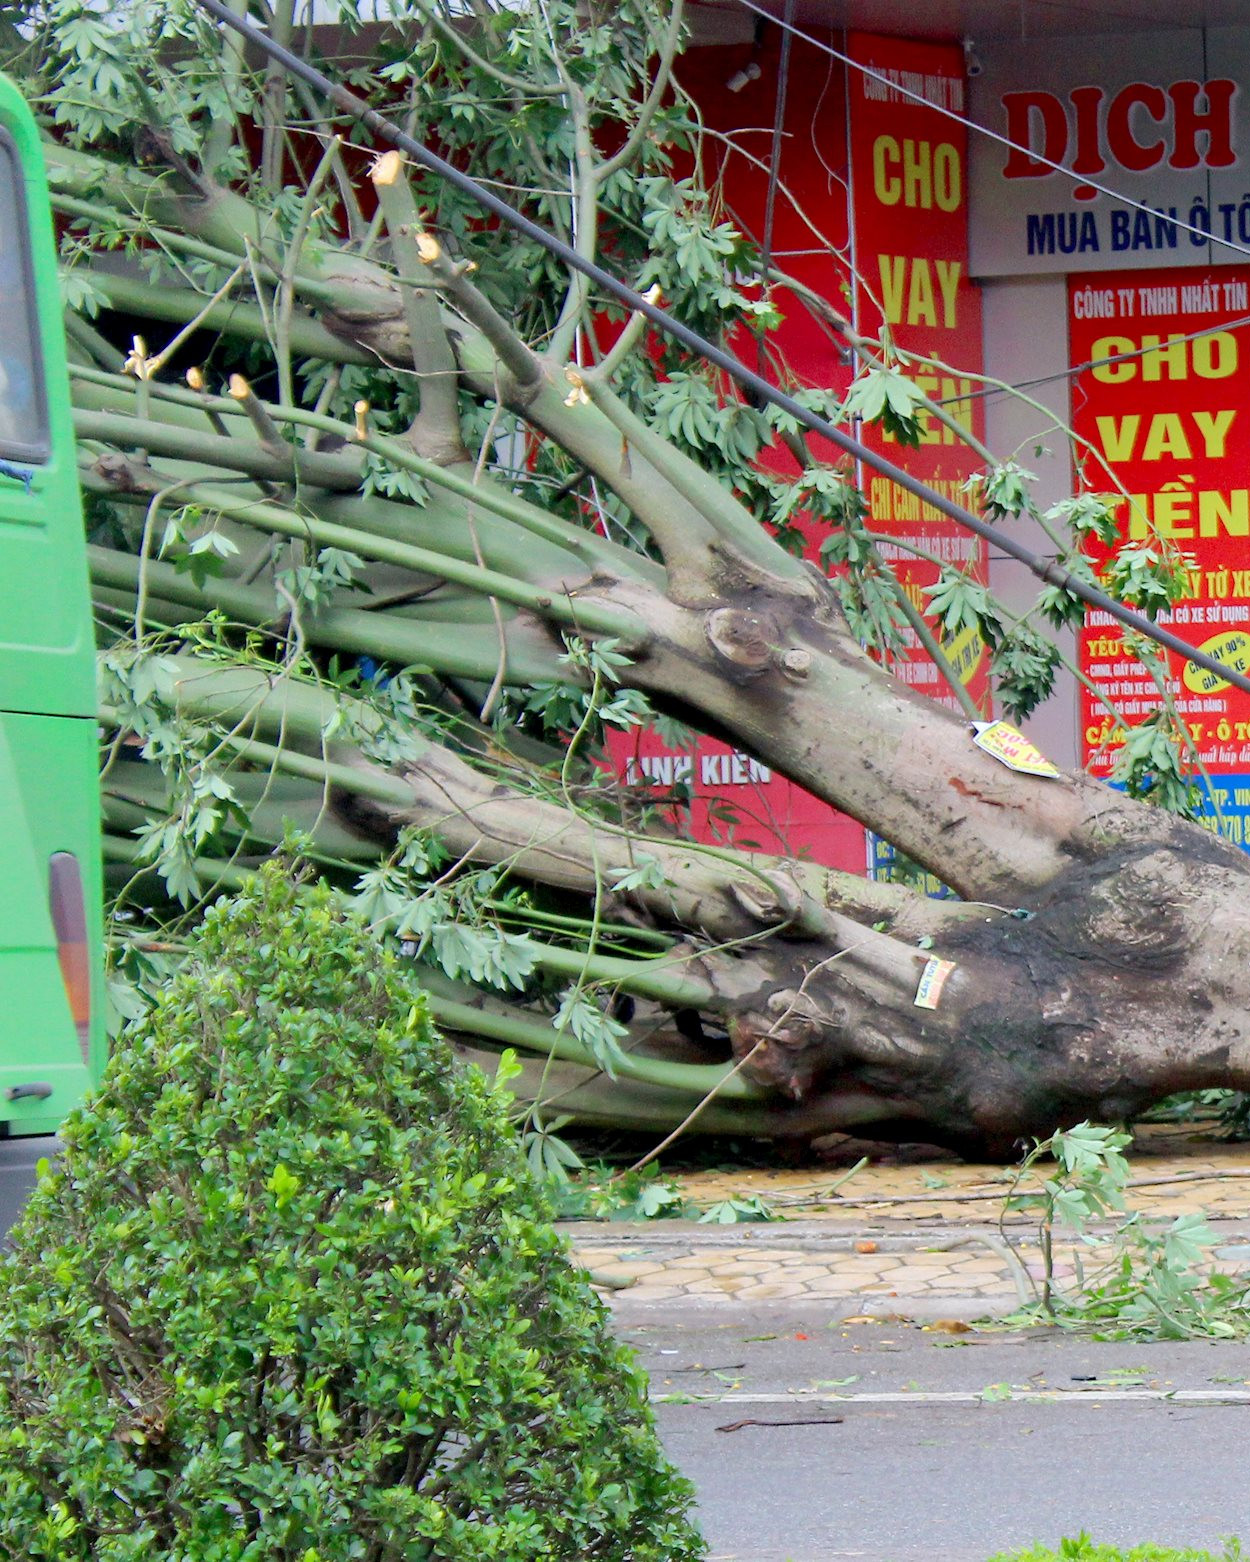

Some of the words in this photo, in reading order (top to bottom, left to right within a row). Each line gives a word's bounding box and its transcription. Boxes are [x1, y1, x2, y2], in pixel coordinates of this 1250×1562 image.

[1001, 80, 1237, 201] DỊCH
[873, 134, 962, 213] CHO
[1027, 210, 1100, 256] MUA
[1111, 200, 1178, 251] BÁN
[1188, 196, 1211, 247] Ô
[877, 253, 962, 330] VAY
[1073, 283, 1115, 320] CÔNG
[1117, 288, 1136, 318] TY
[1138, 286, 1178, 317] TNHH
[1181, 274, 1220, 315] NHẤT
[1223, 276, 1248, 312] TÍN
[1090, 331, 1239, 384] CHO
[1095, 409, 1238, 462] VAY
[1191, 605, 1205, 624] XE
[1086, 635, 1120, 657] YÊU
[1216, 717, 1232, 742] Ô
